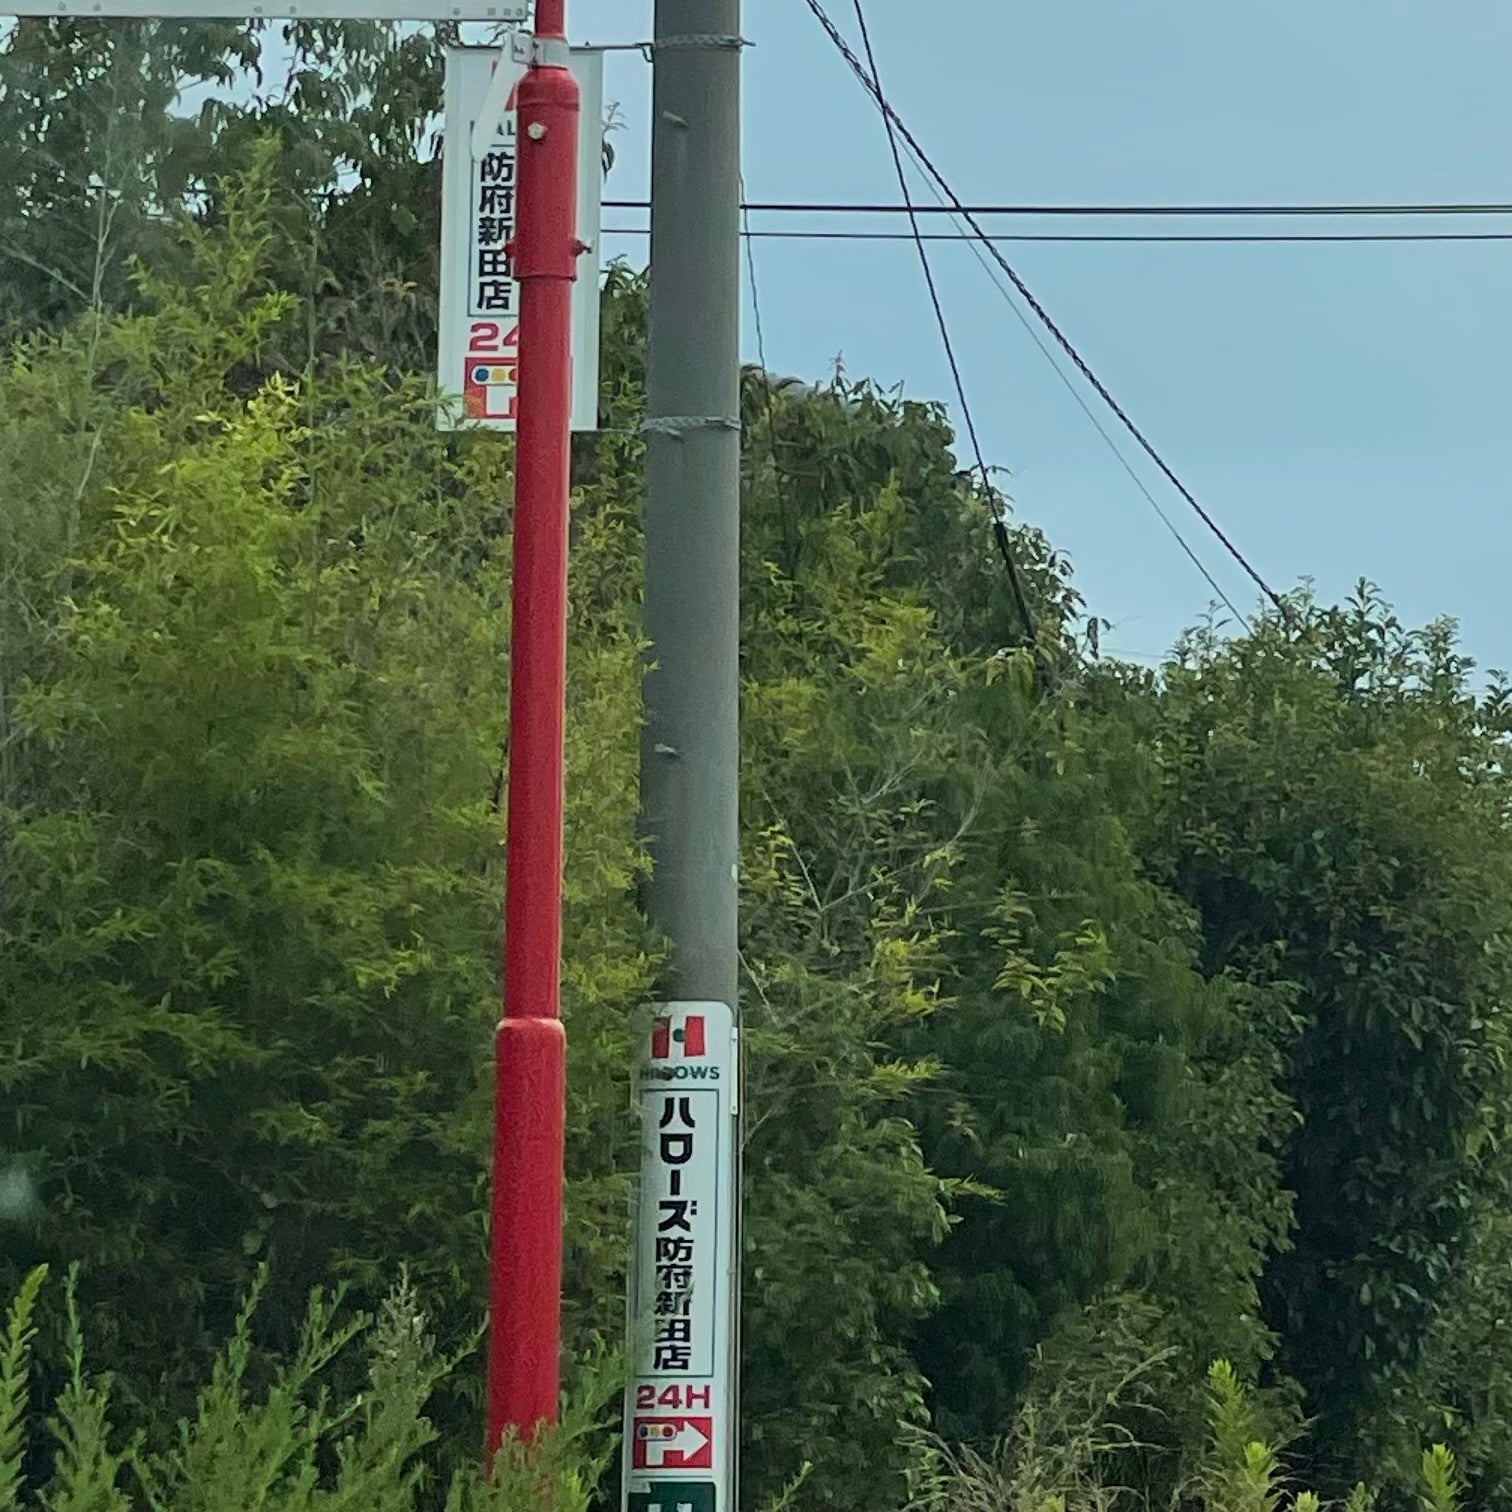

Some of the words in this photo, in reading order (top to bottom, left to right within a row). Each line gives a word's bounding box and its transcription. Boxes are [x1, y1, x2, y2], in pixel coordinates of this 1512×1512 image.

[476, 151, 515, 311] 防府新田店
[635, 1384, 712, 1410] 24H
